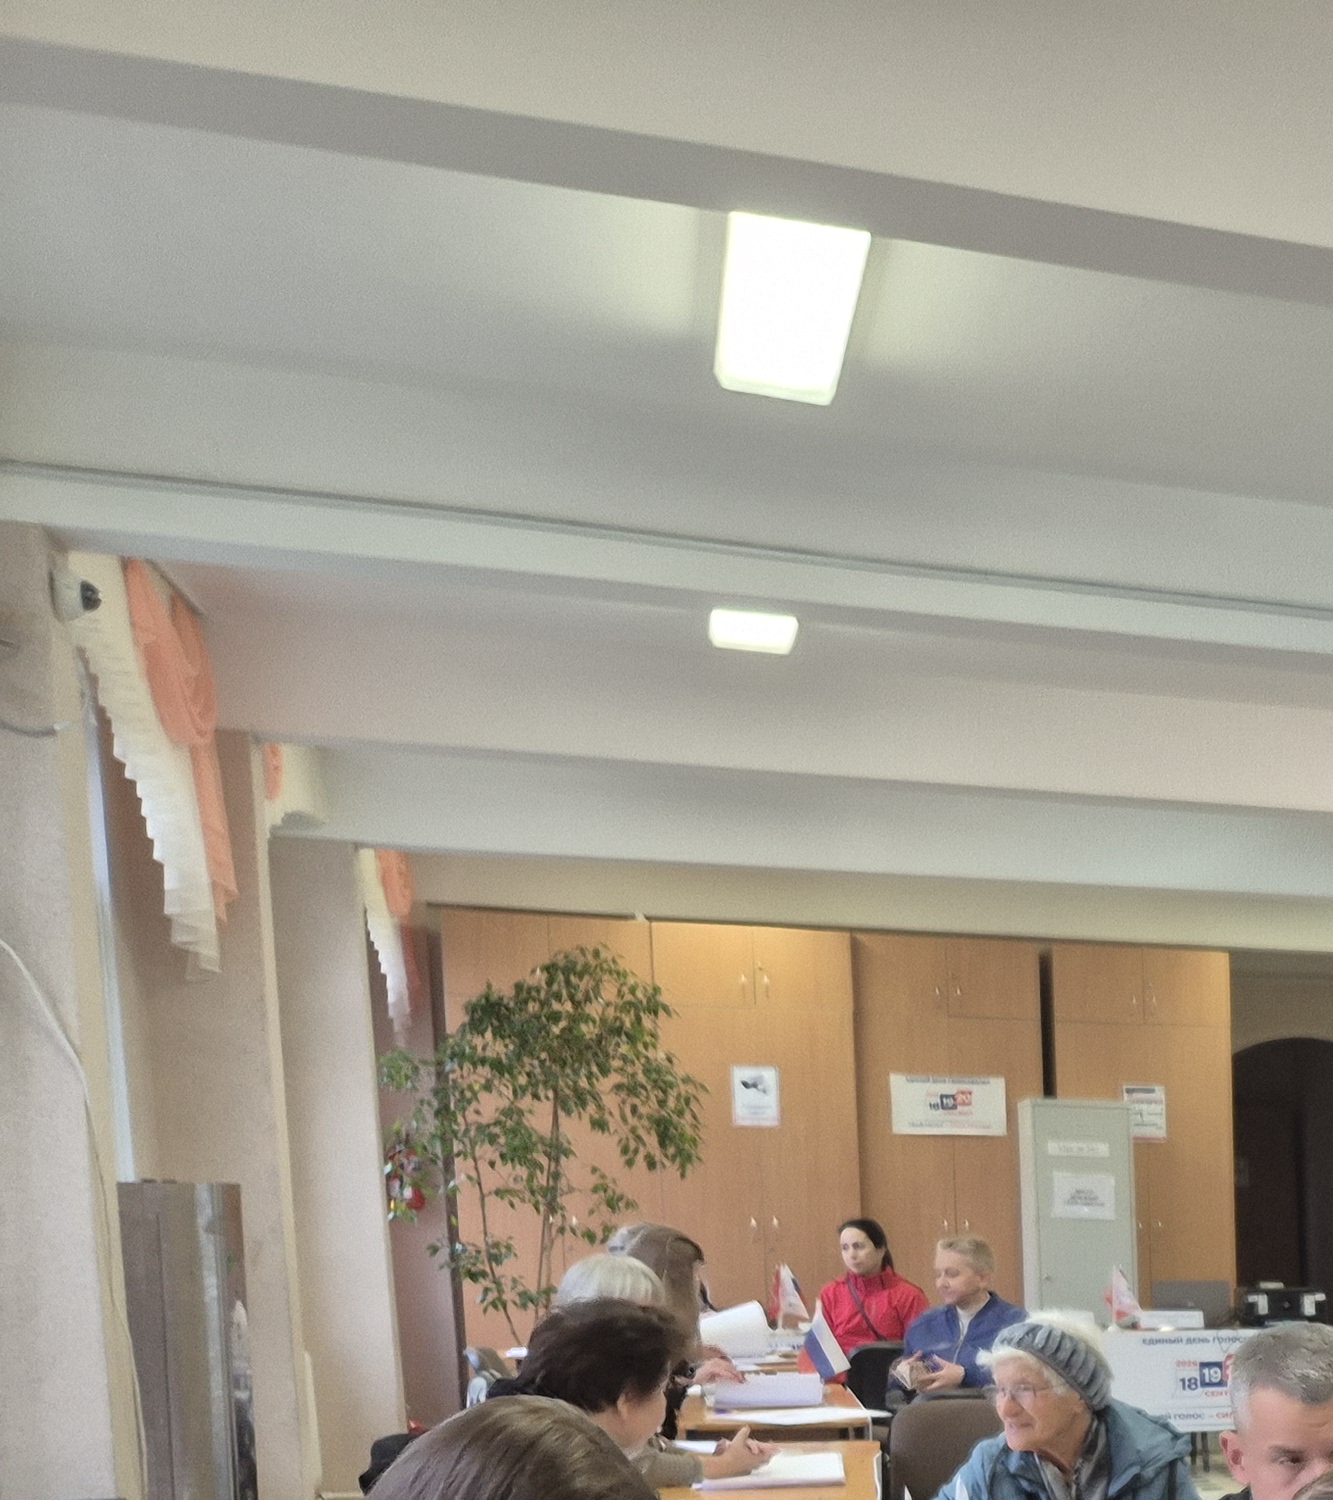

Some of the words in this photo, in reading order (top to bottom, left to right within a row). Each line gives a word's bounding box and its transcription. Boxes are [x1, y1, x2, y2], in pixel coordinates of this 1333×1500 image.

[1142, 1335, 1183, 1346] ЕДИНЫЙ
[1185, 1336, 1211, 1345] ДЕНЬ
[1212, 1336, 1246, 1344] ГОЛОС
[1202, 1366, 1221, 1383] 19
[1179, 1376, 1198, 1391] 18
